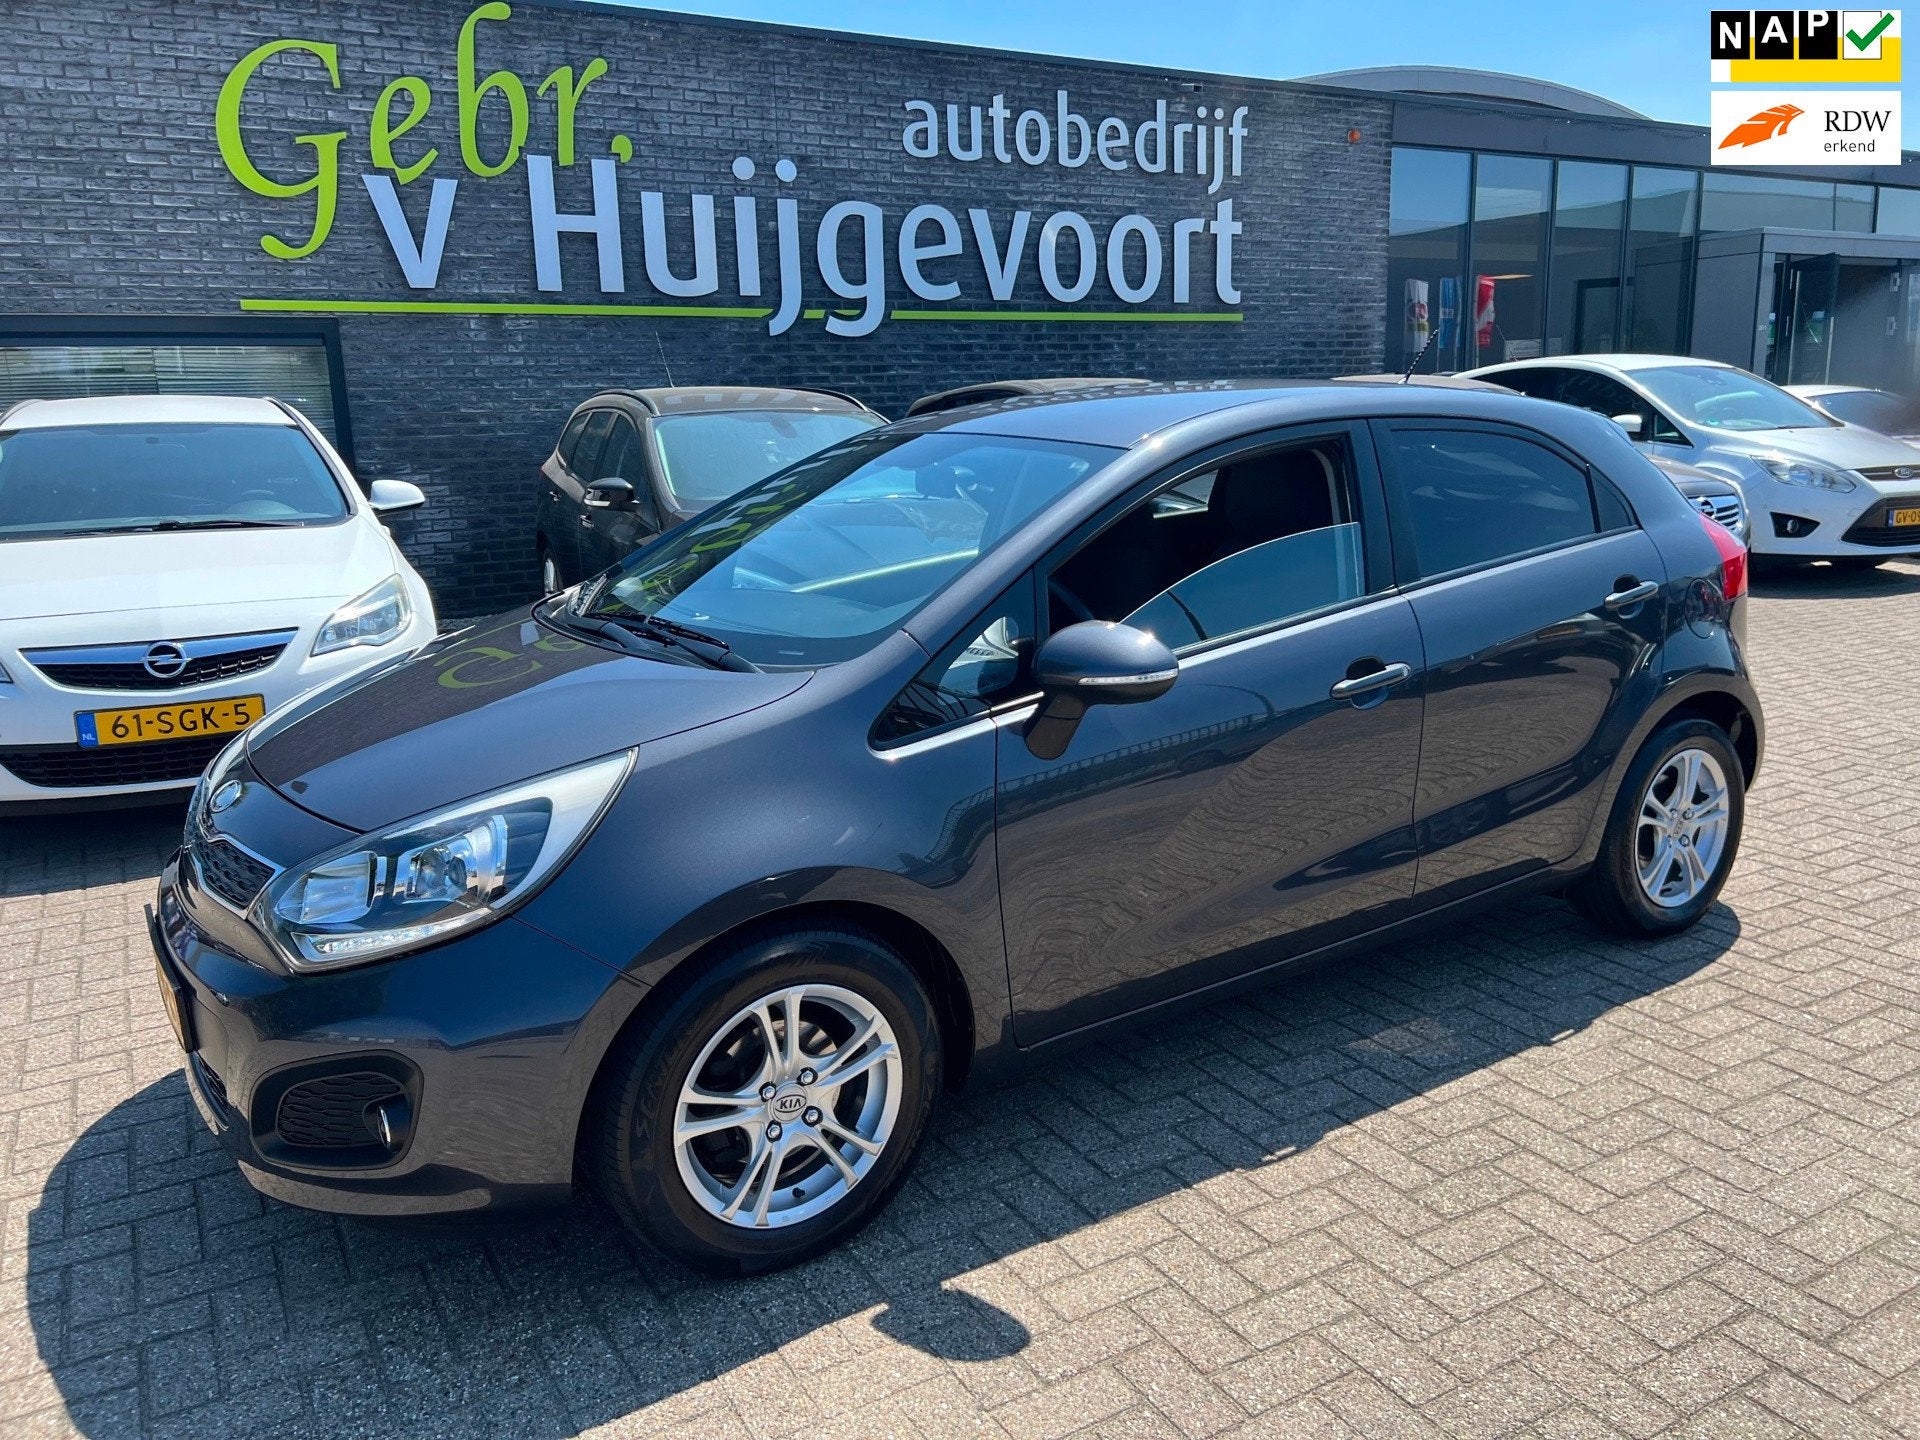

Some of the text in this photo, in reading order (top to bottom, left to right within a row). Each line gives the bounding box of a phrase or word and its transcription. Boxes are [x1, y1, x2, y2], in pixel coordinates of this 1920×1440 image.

[902, 89, 1249, 195] autobedrijf
[526, 154, 1242, 338] Huijgevoort
[82, 733, 96, 741] NL
[111, 703, 251, 738] 61-SGK-5
[780, 1098, 801, 1109] KIA
